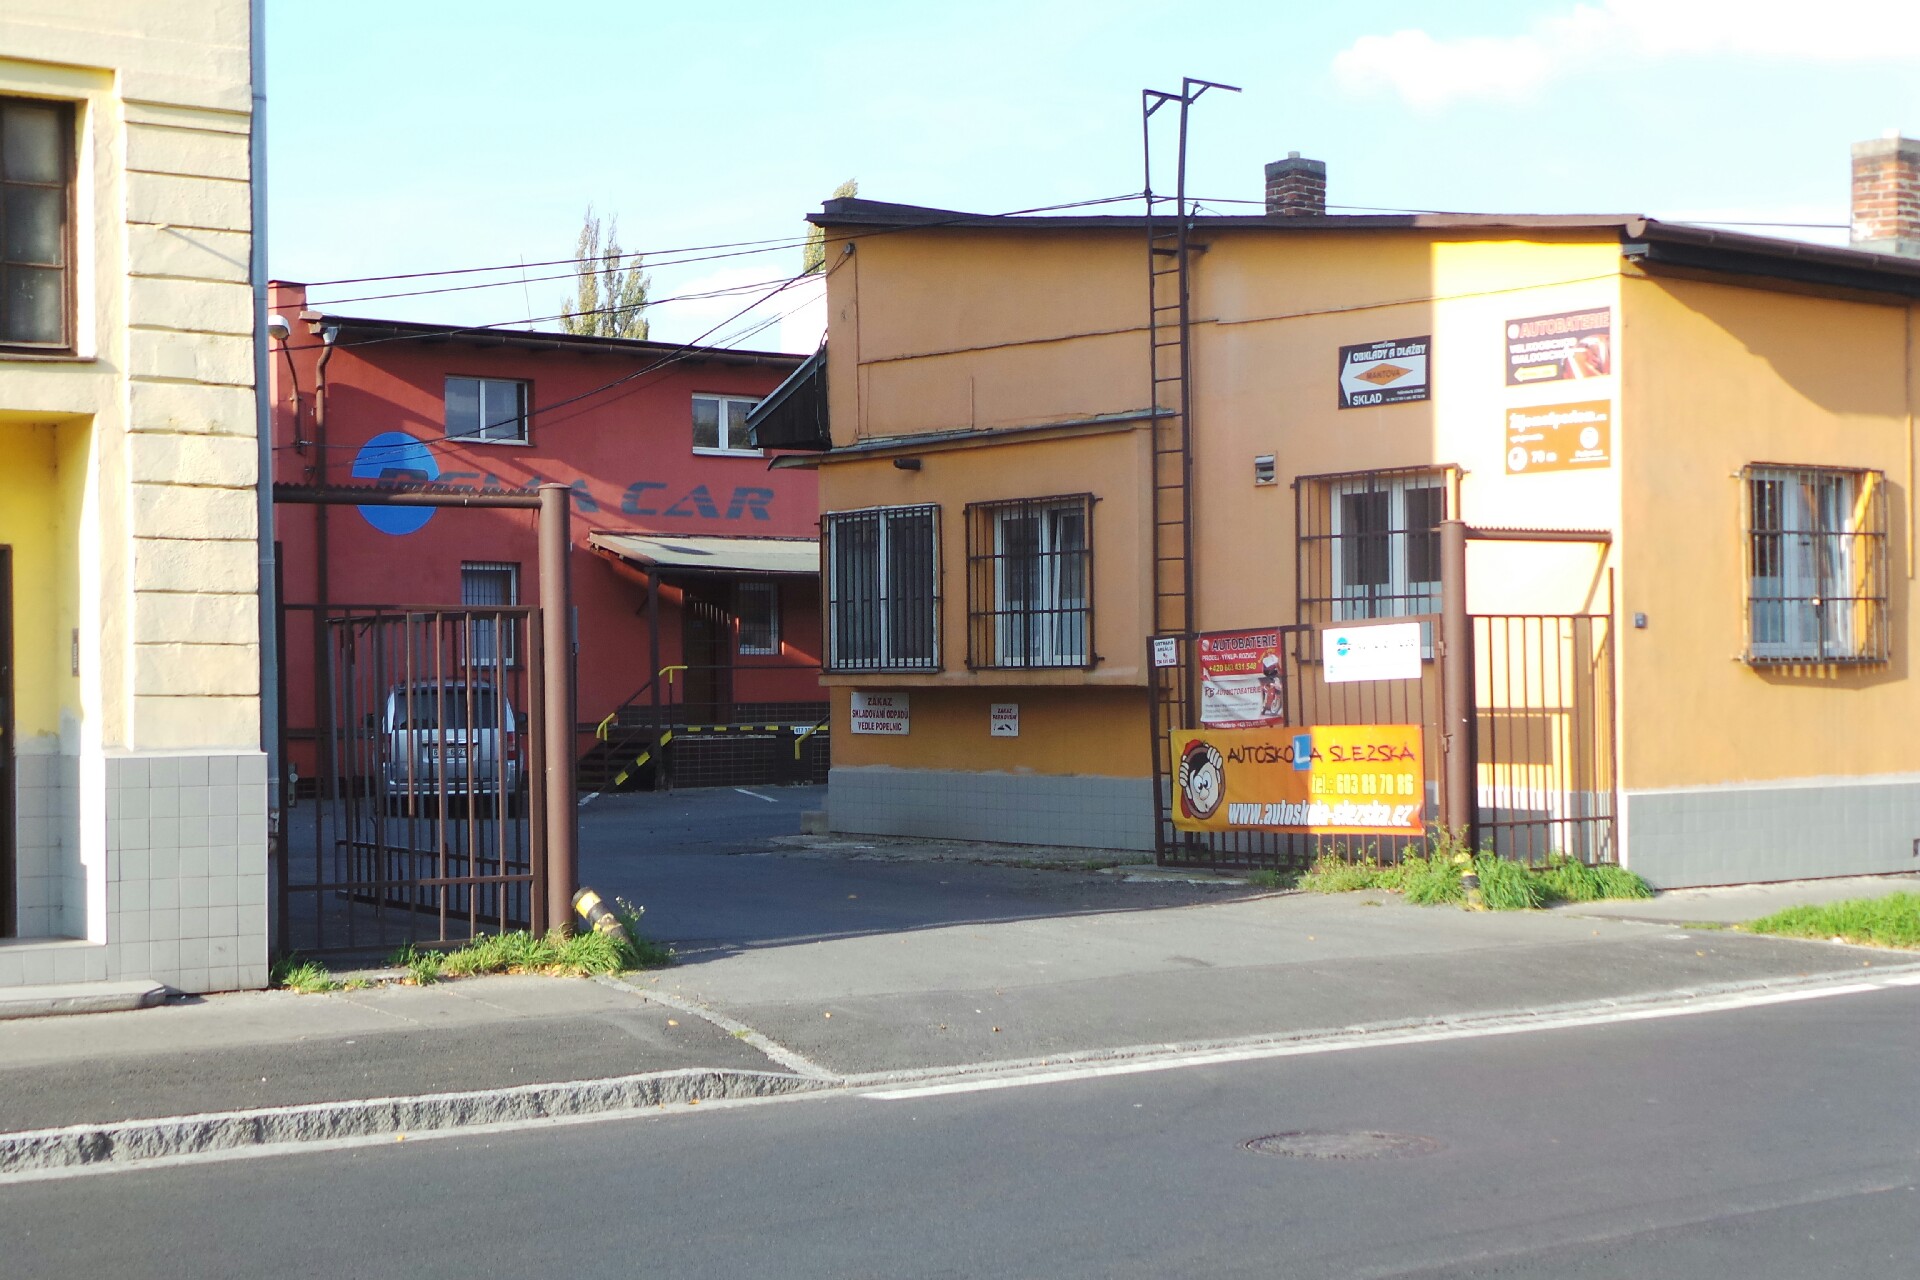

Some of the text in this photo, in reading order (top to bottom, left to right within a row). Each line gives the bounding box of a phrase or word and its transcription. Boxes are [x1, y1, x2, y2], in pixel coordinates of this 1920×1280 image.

[1353, 349, 1387, 362] OBKLADY
[1389, 348, 1395, 358] A
[1397, 343, 1426, 357] DLAŽBY
[1366, 369, 1400, 379] MANTOVA
[1353, 393, 1382, 405] SKLAD
[621, 481, 774, 520] CAR
[1212, 634, 1277, 651] AUTOBATERIE
[1209, 664, 1223, 672] +420
[857, 721, 902, 731] VEDLE POPELNIC
[1228, 740, 1323, 765] AUTOŠKOLA
[1336, 773, 1358, 794] 603
[1380, 773, 1394, 795] 70
[1228, 800, 1413, 827] www.autoskola-slezska.cz
